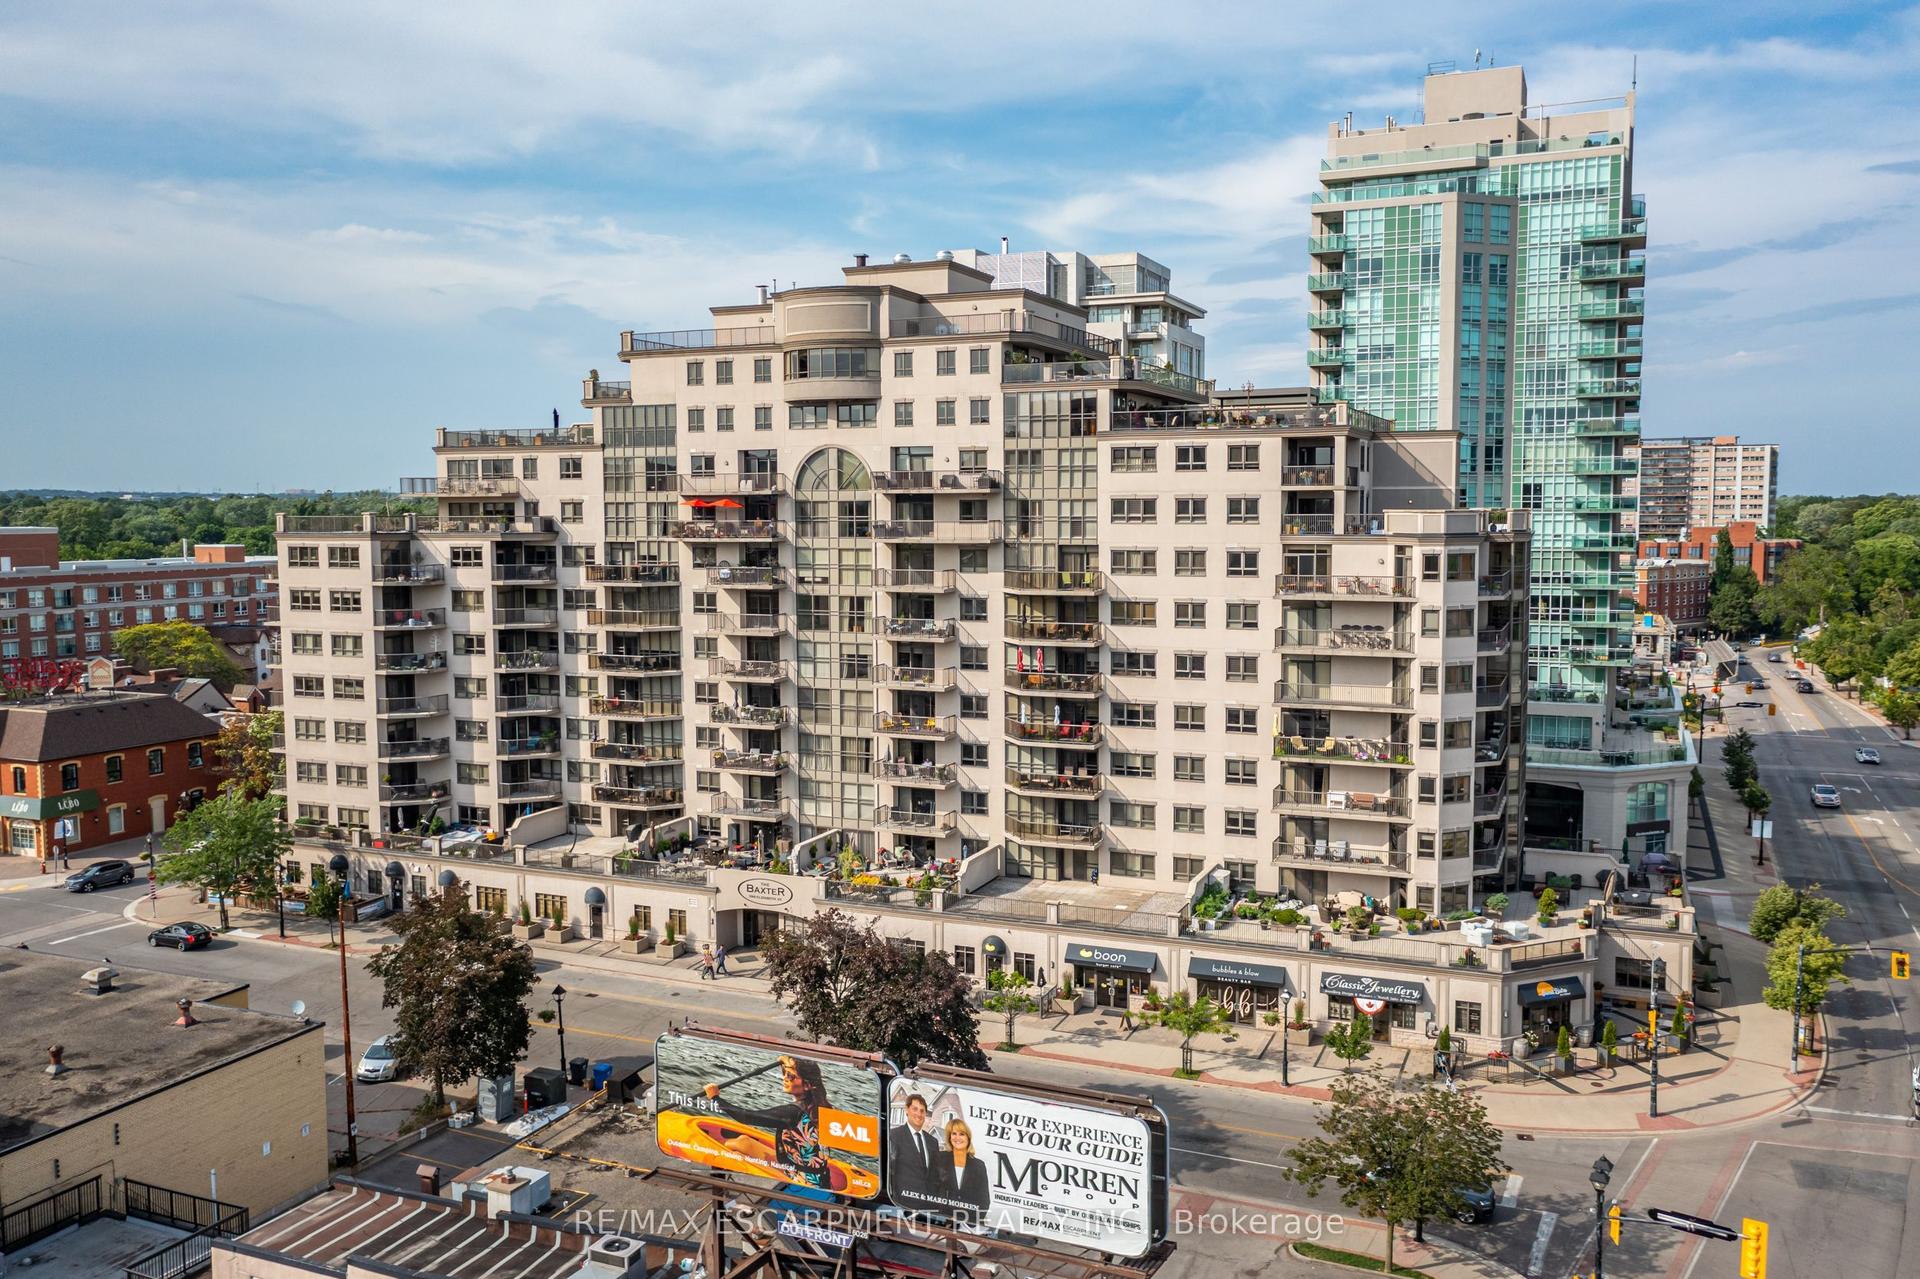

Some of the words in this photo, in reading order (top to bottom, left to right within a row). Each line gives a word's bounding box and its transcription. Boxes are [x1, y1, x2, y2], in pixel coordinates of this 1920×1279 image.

[11, 801, 29, 813] LCBO
[58, 799, 80, 810] LCBO
[746, 884, 785, 896] BAXTER
[1093, 949, 1127, 963] boon
[1212, 964, 1237, 975] bubbles
[1244, 967, 1260, 977] blow
[1325, 974, 1366, 990] Classic
[1365, 979, 1420, 999] Jewellery
[668, 1090, 693, 1108] This
[696, 1096, 707, 1111] is
[709, 1098, 723, 1113] it.
[828, 1121, 871, 1143] SAIL
[969, 1105, 997, 1121] LET
[1000, 1111, 1038, 1129] OUR
[1042, 1119, 1143, 1150] EXPERIENCE
[985, 1123, 1012, 1141] BE
[1016, 1128, 1072, 1153] YOUR
[1076, 1141, 1144, 1167] GUIDE
[993, 1150, 1140, 1200] MORREN
[901, 1189, 920, 1200] ALEX
[926, 1194, 948, 1205] MARG
[948, 1199, 980, 1212] MORREN
[994, 1193, 1022, 1205] INDUSTRY
[1023, 1199, 1049, 1210] LEADERS
[1095, 1215, 1142, 1231] ELAIONSHIPS
[780, 1222, 850, 1246] OUTFRONT
[1023, 1216, 1061, 1232] RE/MAX
[1063, 1224, 1102, 1237] ESCARPENT
